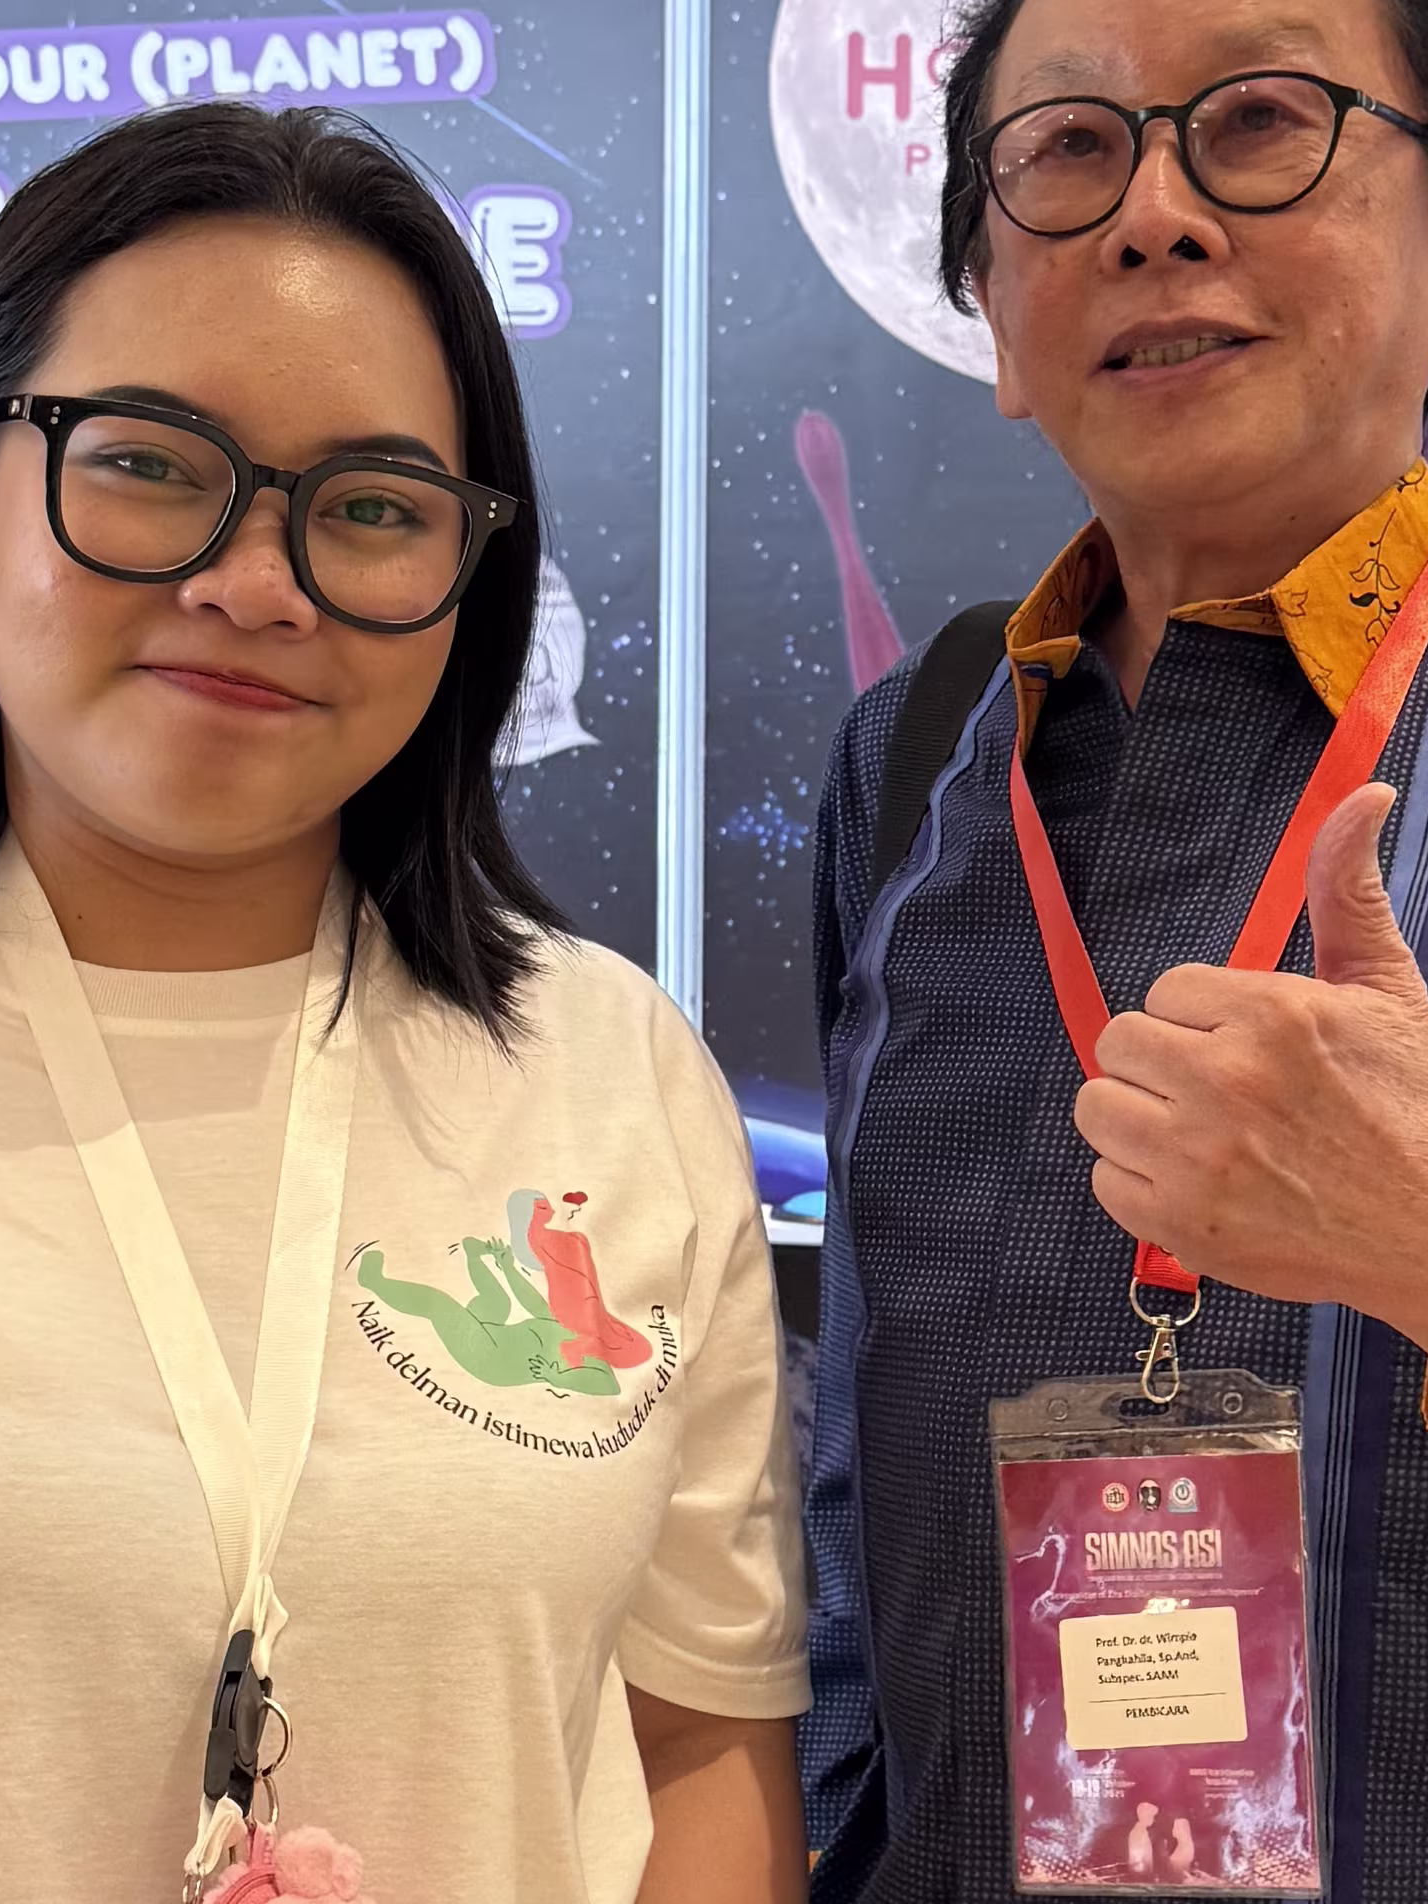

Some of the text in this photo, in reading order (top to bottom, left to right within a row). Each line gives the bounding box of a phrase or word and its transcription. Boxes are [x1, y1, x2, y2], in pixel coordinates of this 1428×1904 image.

[131, 15, 484, 109] (PLANET)
[352, 1299, 395, 1353] Naik
[385, 1351, 479, 1425] delman
[480, 1410, 595, 1459] istimewa
[655, 1364, 674, 1395] di
[1084, 1528, 1223, 1571] SIMNAS ASI
